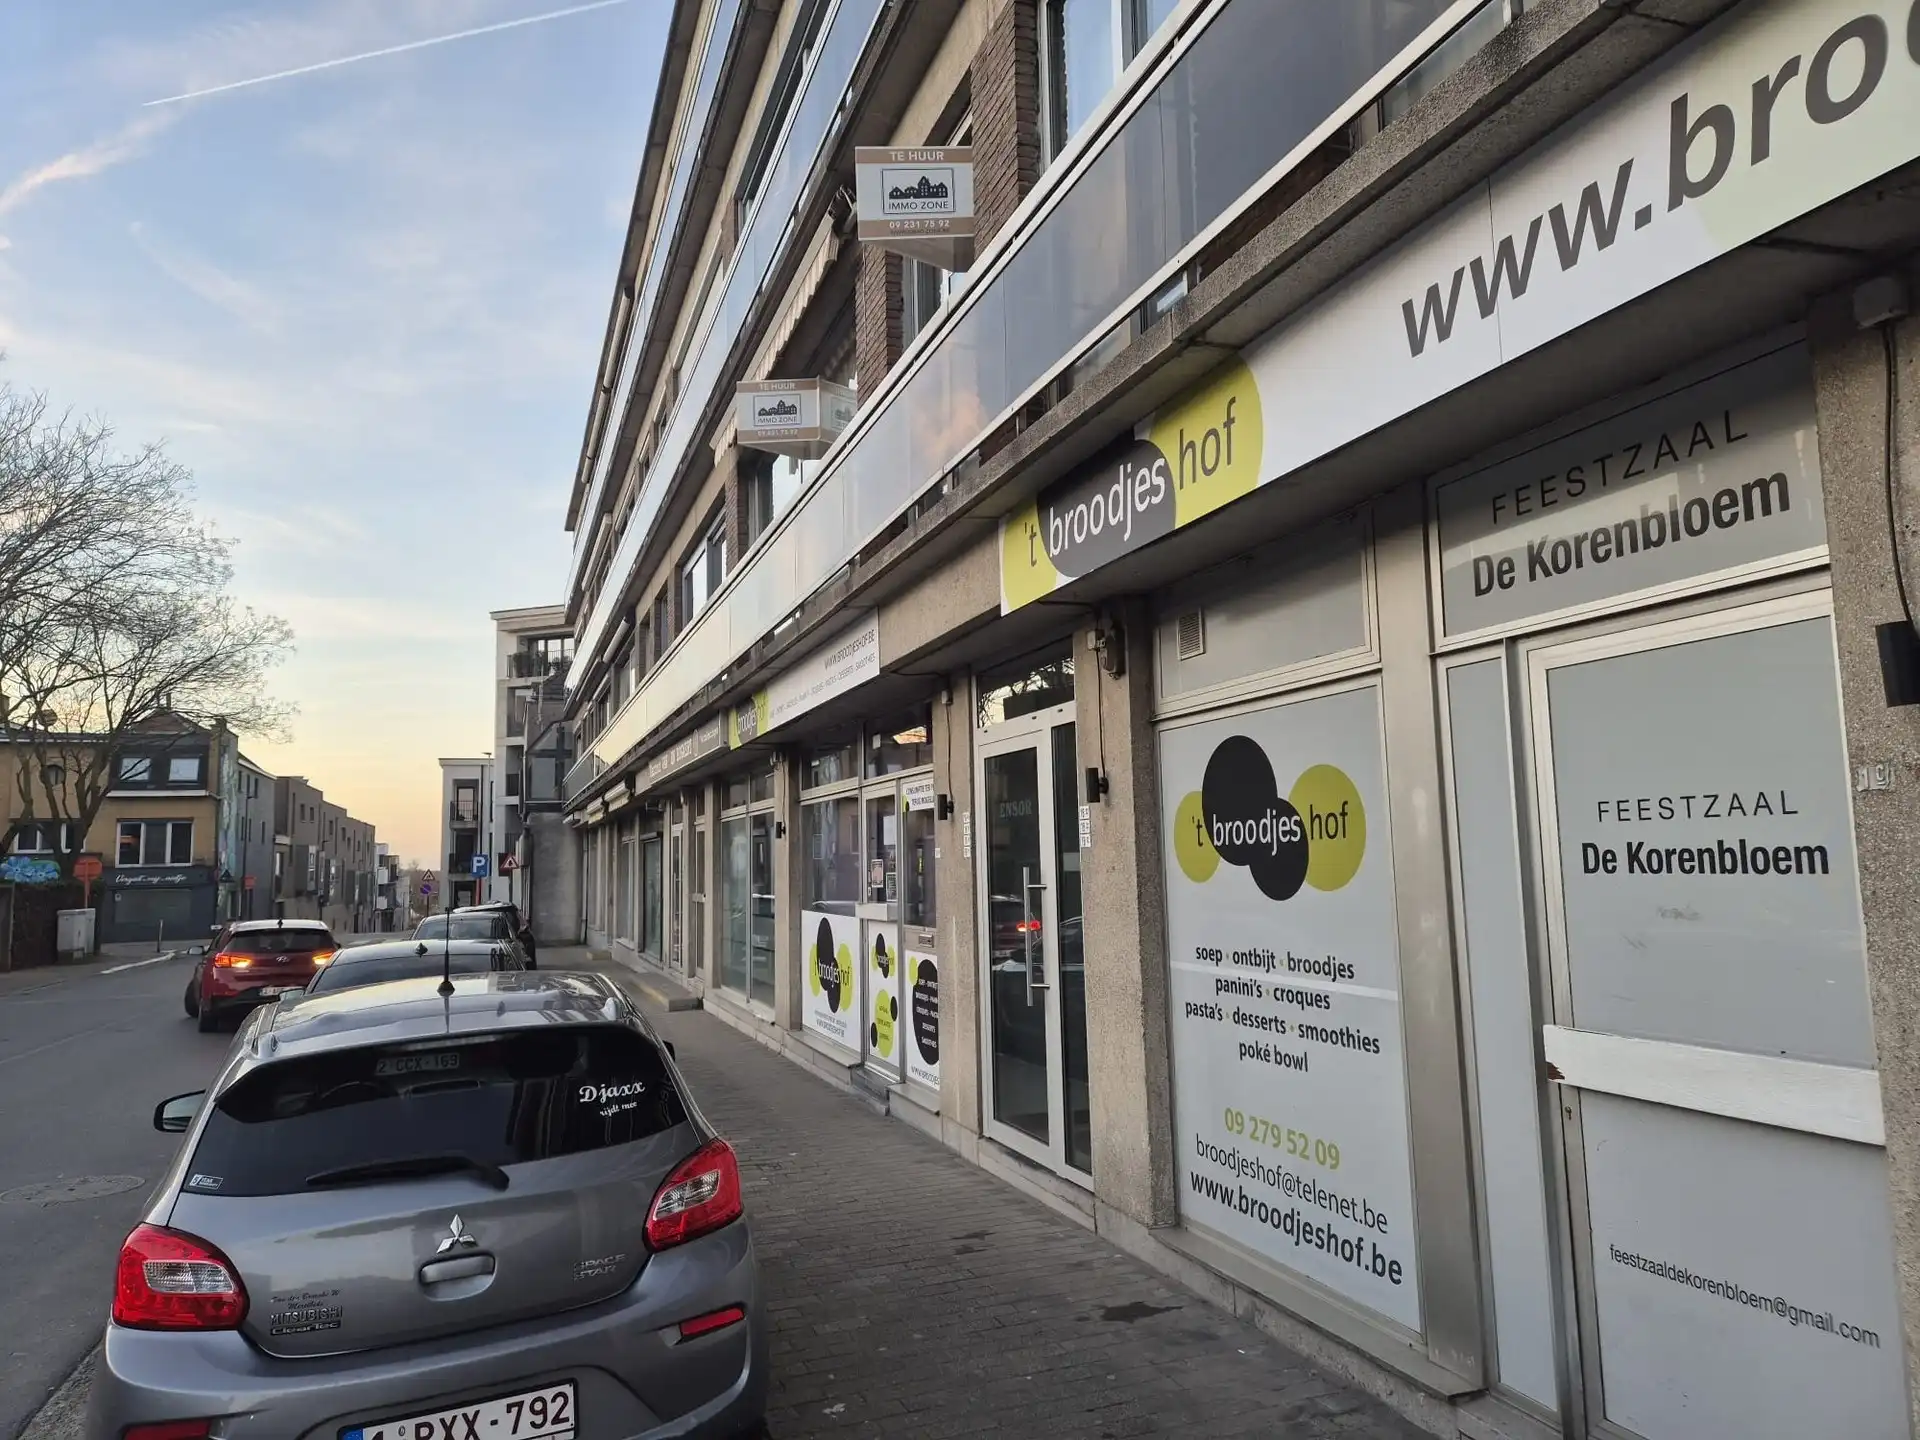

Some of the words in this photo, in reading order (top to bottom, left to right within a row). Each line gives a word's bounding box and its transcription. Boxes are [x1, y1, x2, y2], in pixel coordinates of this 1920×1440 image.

[889, 151, 905, 161] TE
[909, 151, 944, 161] HUUR
[1401, 0, 1920, 358] www.bro
[889, 202, 918, 210] IMMO
[921, 201, 949, 210] ZONE
[889, 221, 900, 229] 09
[904, 221, 920, 229] 231
[771, 382, 796, 390] HUUR
[1024, 522, 1038, 568] 't
[1050, 457, 1166, 558] broodjes
[1179, 396, 1236, 491] hof
[1492, 410, 1748, 525] FEESTZAAL
[1473, 554, 1516, 598] De
[1527, 471, 1791, 583] Korenbloem
[1597, 790, 1799, 822] FEESTZAAL
[1191, 815, 1203, 847] 't
[1212, 808, 1301, 857] broodjes
[1310, 801, 1349, 841] hof
[472, 856, 486, 873] P
[1582, 842, 1617, 875] De
[1626, 838, 1830, 876] Korenbloem
[1195, 946, 1223, 967] soep
[1232, 948, 1276, 974] ontbijt
[1287, 951, 1355, 983] broodjes
[1215, 977, 1263, 999] panini's
[1273, 985, 1331, 1011] croques
[1185, 1000, 1223, 1022] pasta's
[1232, 1006, 1286, 1035] desserts
[1298, 1023, 1380, 1054] smoothies
[1238, 1040, 1271, 1063] poké
[1274, 1044, 1309, 1072] bowl
[579, 1082, 646, 1104] Djaxx
[621, 1101, 638, 1110] mee
[1224, 1107, 1244, 1135] 09
[1249, 1116, 1281, 1148] 279
[1287, 1128, 1310, 1160] 52
[1315, 1138, 1341, 1170] 09
[1196, 1133, 1388, 1235] broodjeshof@telenet.be
[1190, 1171, 1403, 1286] www.broodjeshof.be
[1609, 1243, 1881, 1349] feestzaaldekorenbloem@gmail.com
[271, 1305, 343, 1325] MITSUBISHI
